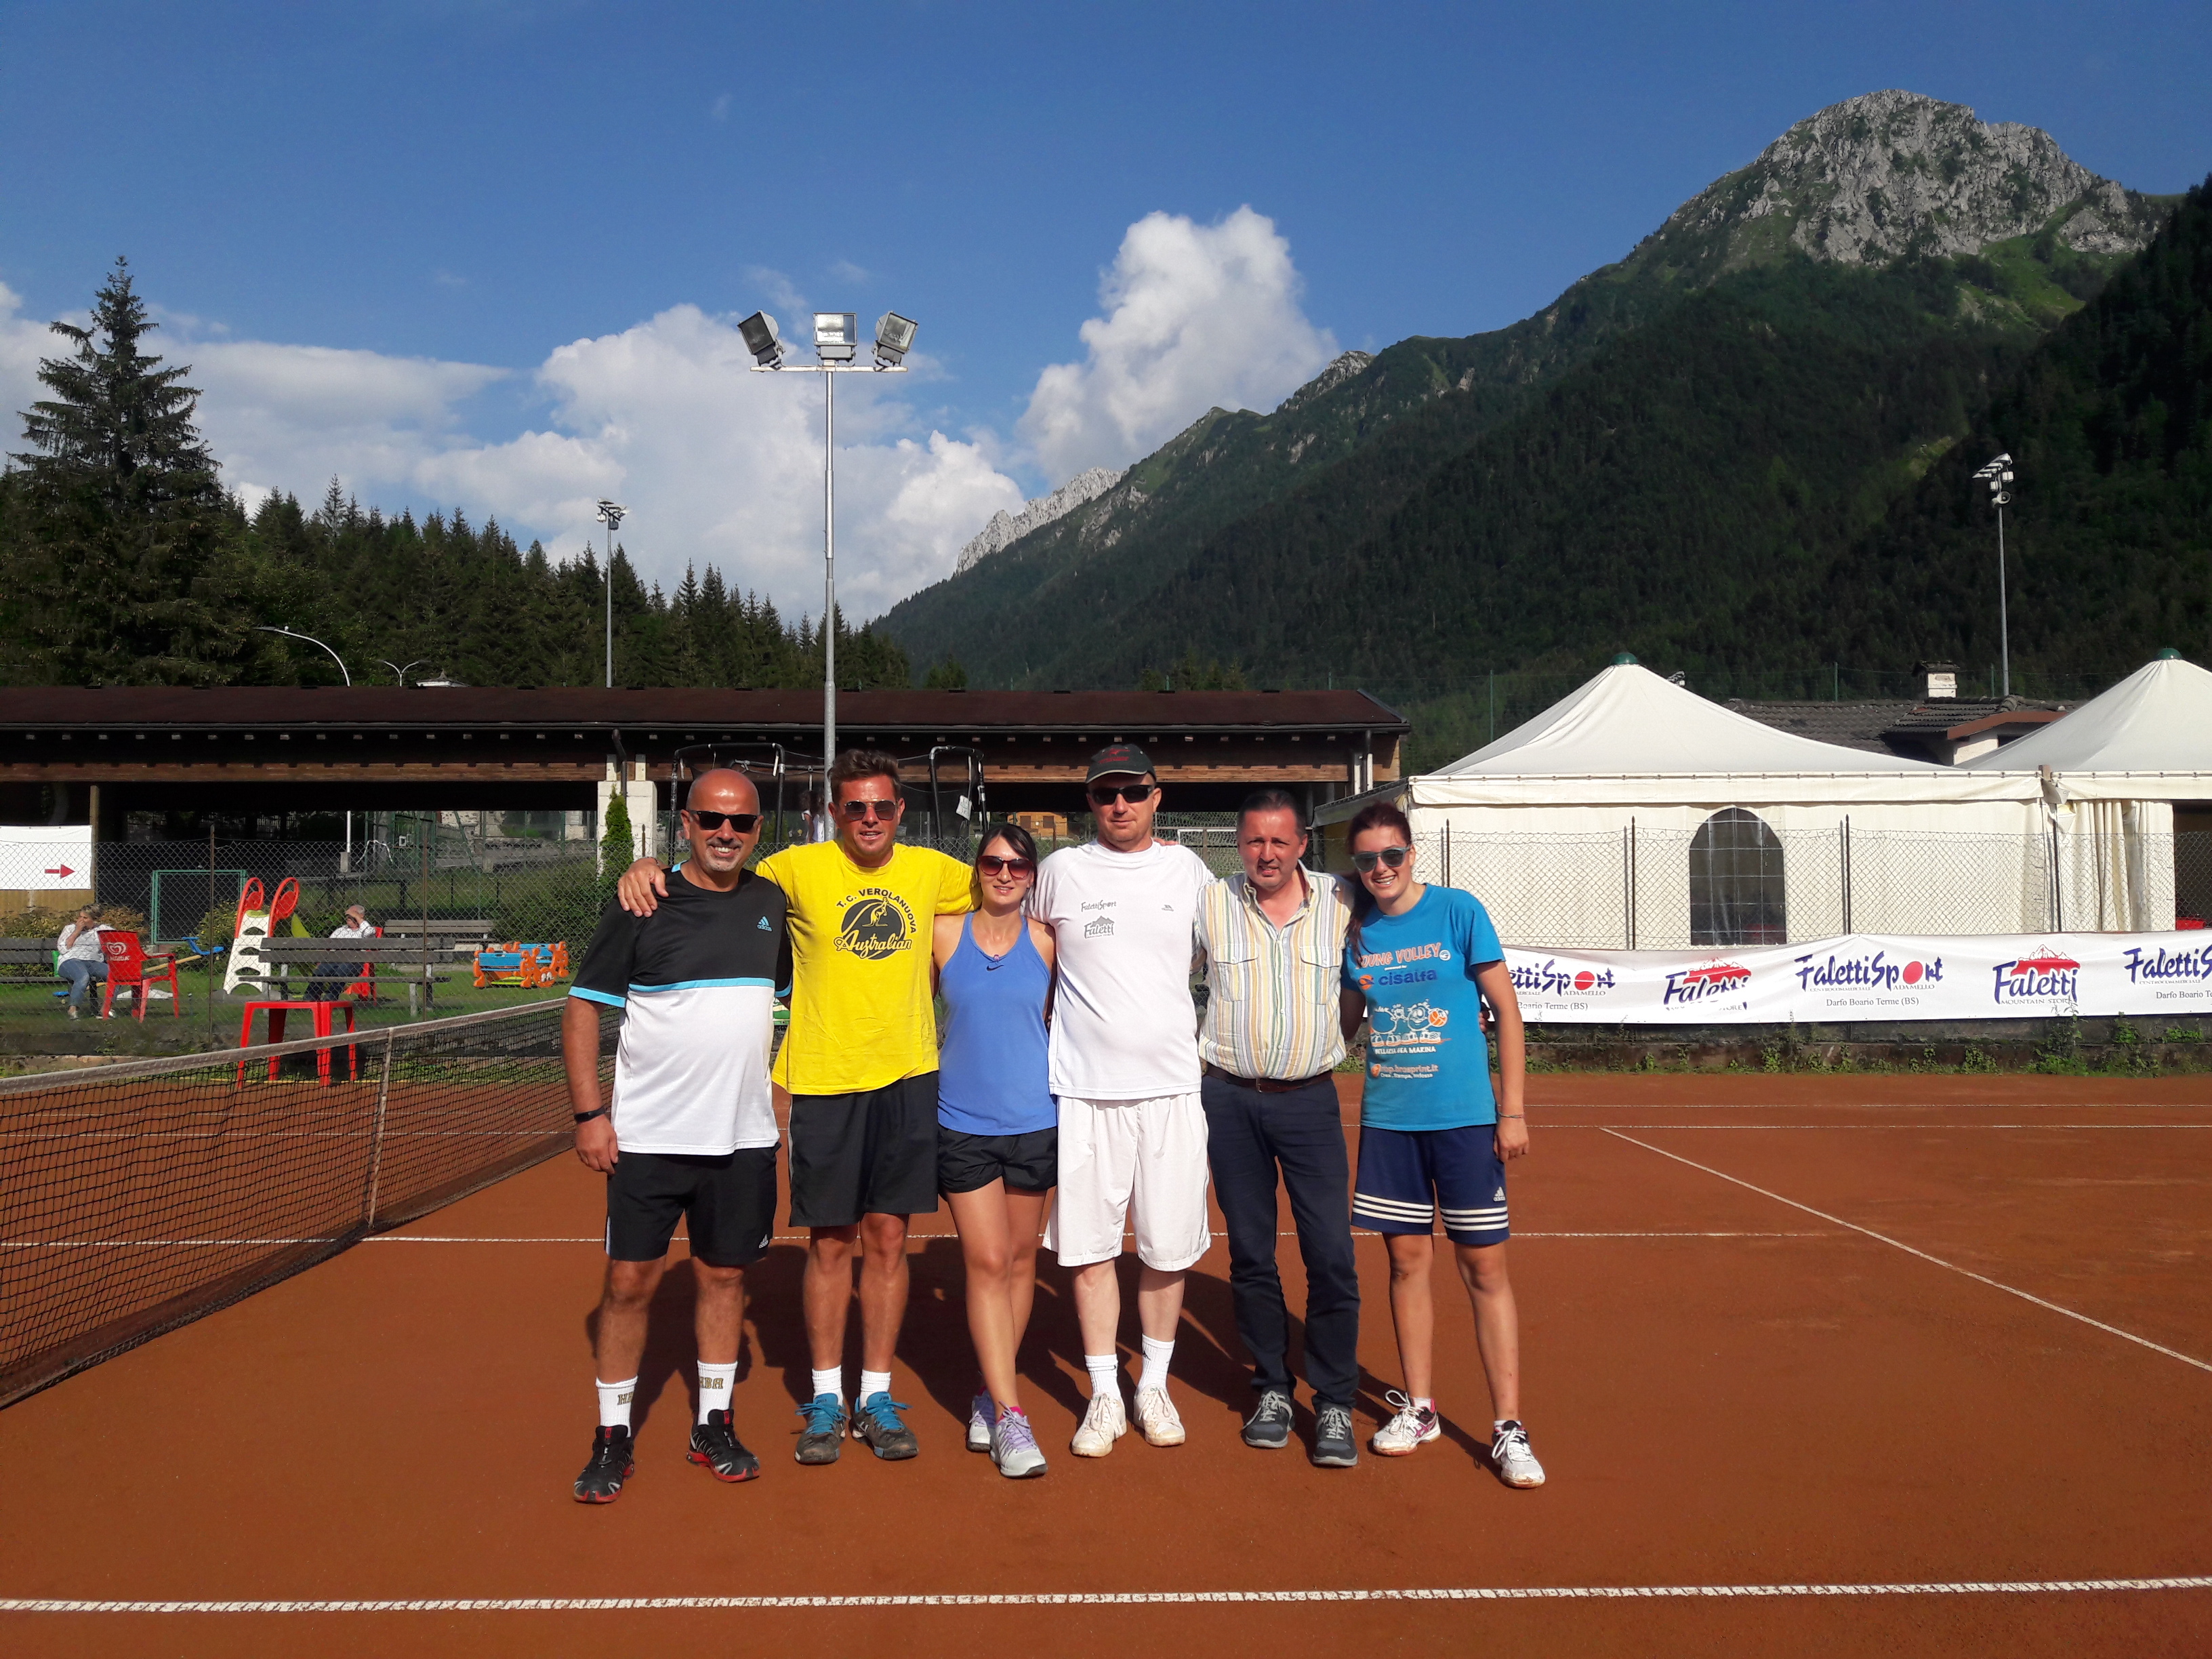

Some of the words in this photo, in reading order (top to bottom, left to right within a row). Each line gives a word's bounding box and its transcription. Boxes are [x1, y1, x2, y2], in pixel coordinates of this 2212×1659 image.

[836, 900, 846, 908] T.
[846, 895, 857, 903] C.
[858, 888, 916, 933] VEROLANUOVA
[834, 929, 913, 960] Australian
[1084, 922, 1113, 939] Faletti
[1358, 951, 1393, 968] OUNG
[1395, 942, 1441, 964] VOLLEY
[2123, 944, 2212, 985] FalettiS
[1378, 969, 1437, 985] cisalfa
[1509, 959, 1616, 997] ettiSport
[1794, 950, 1944, 991] FalettiSport
[1992, 961, 2078, 1004] Faletti
[1544, 1002, 1568, 1010] Terme
[1570, 1002, 1589, 1011] (BS)
[1826, 998, 1847, 1006] Darfo
[1849, 998, 1874, 1006] Boario
[1875, 998, 1900, 1006] Terme
[1901, 997, 1919, 1006] (BS)
[2156, 991, 2177, 999] Darfo
[2179, 989, 2203, 998] Boario
